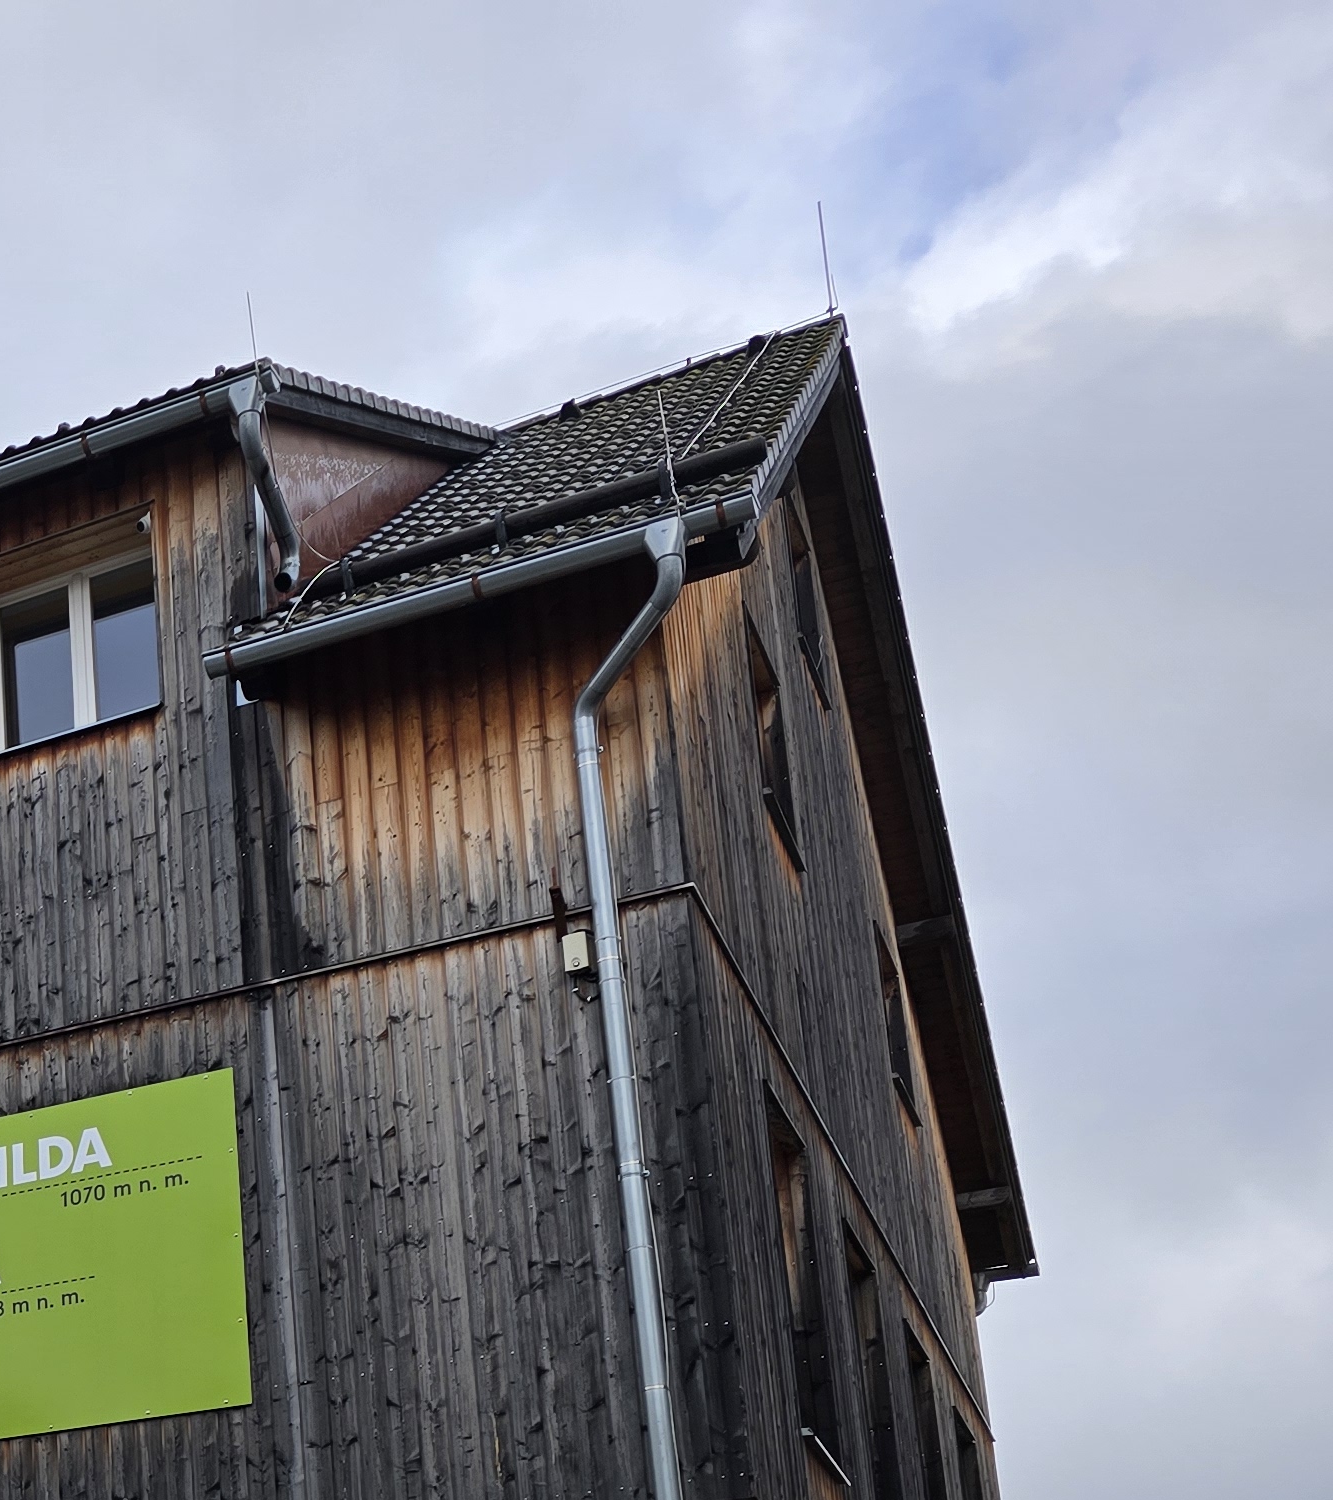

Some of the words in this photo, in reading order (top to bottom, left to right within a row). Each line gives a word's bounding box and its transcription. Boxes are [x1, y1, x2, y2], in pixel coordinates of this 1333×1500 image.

[60, 1184, 106, 1207] 1070
[114, 1183, 131, 1198] m
[139, 1179, 157, 1193] n.
[165, 1173, 189, 1188] m.
[12, 1298, 30, 1315] m
[37, 1295, 55, 1311] n.
[62, 1291, 86, 1306] m.
